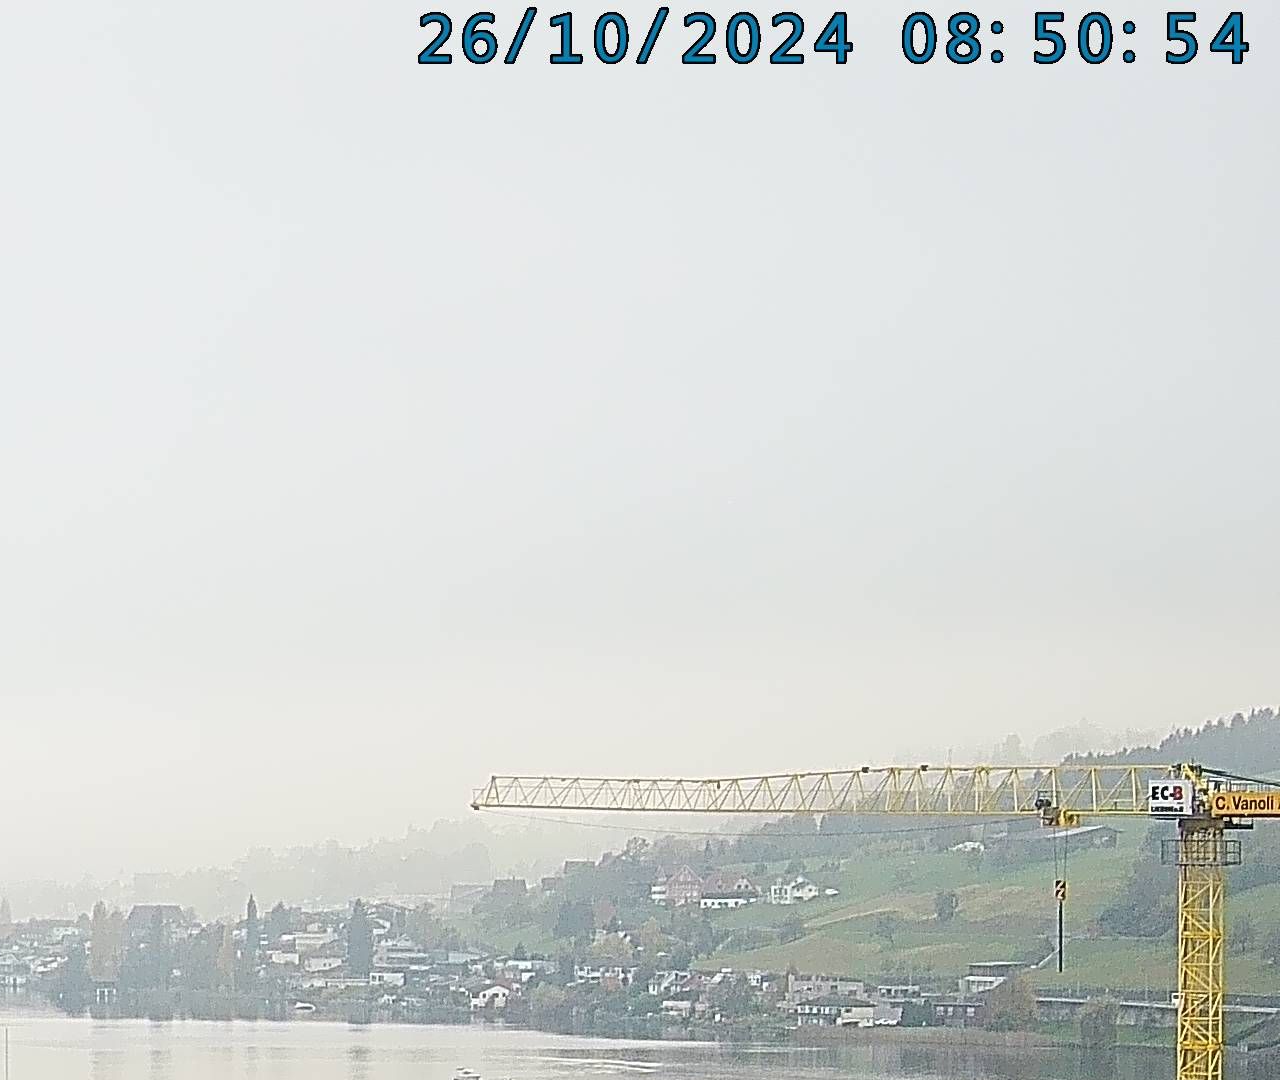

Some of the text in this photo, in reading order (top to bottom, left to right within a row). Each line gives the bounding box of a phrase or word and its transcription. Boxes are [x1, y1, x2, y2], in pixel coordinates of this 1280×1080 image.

[1151, 785, 1184, 801] EC-B
[1215, 795, 1230, 811] C.
[1232, 795, 1274, 811] Vanoli
